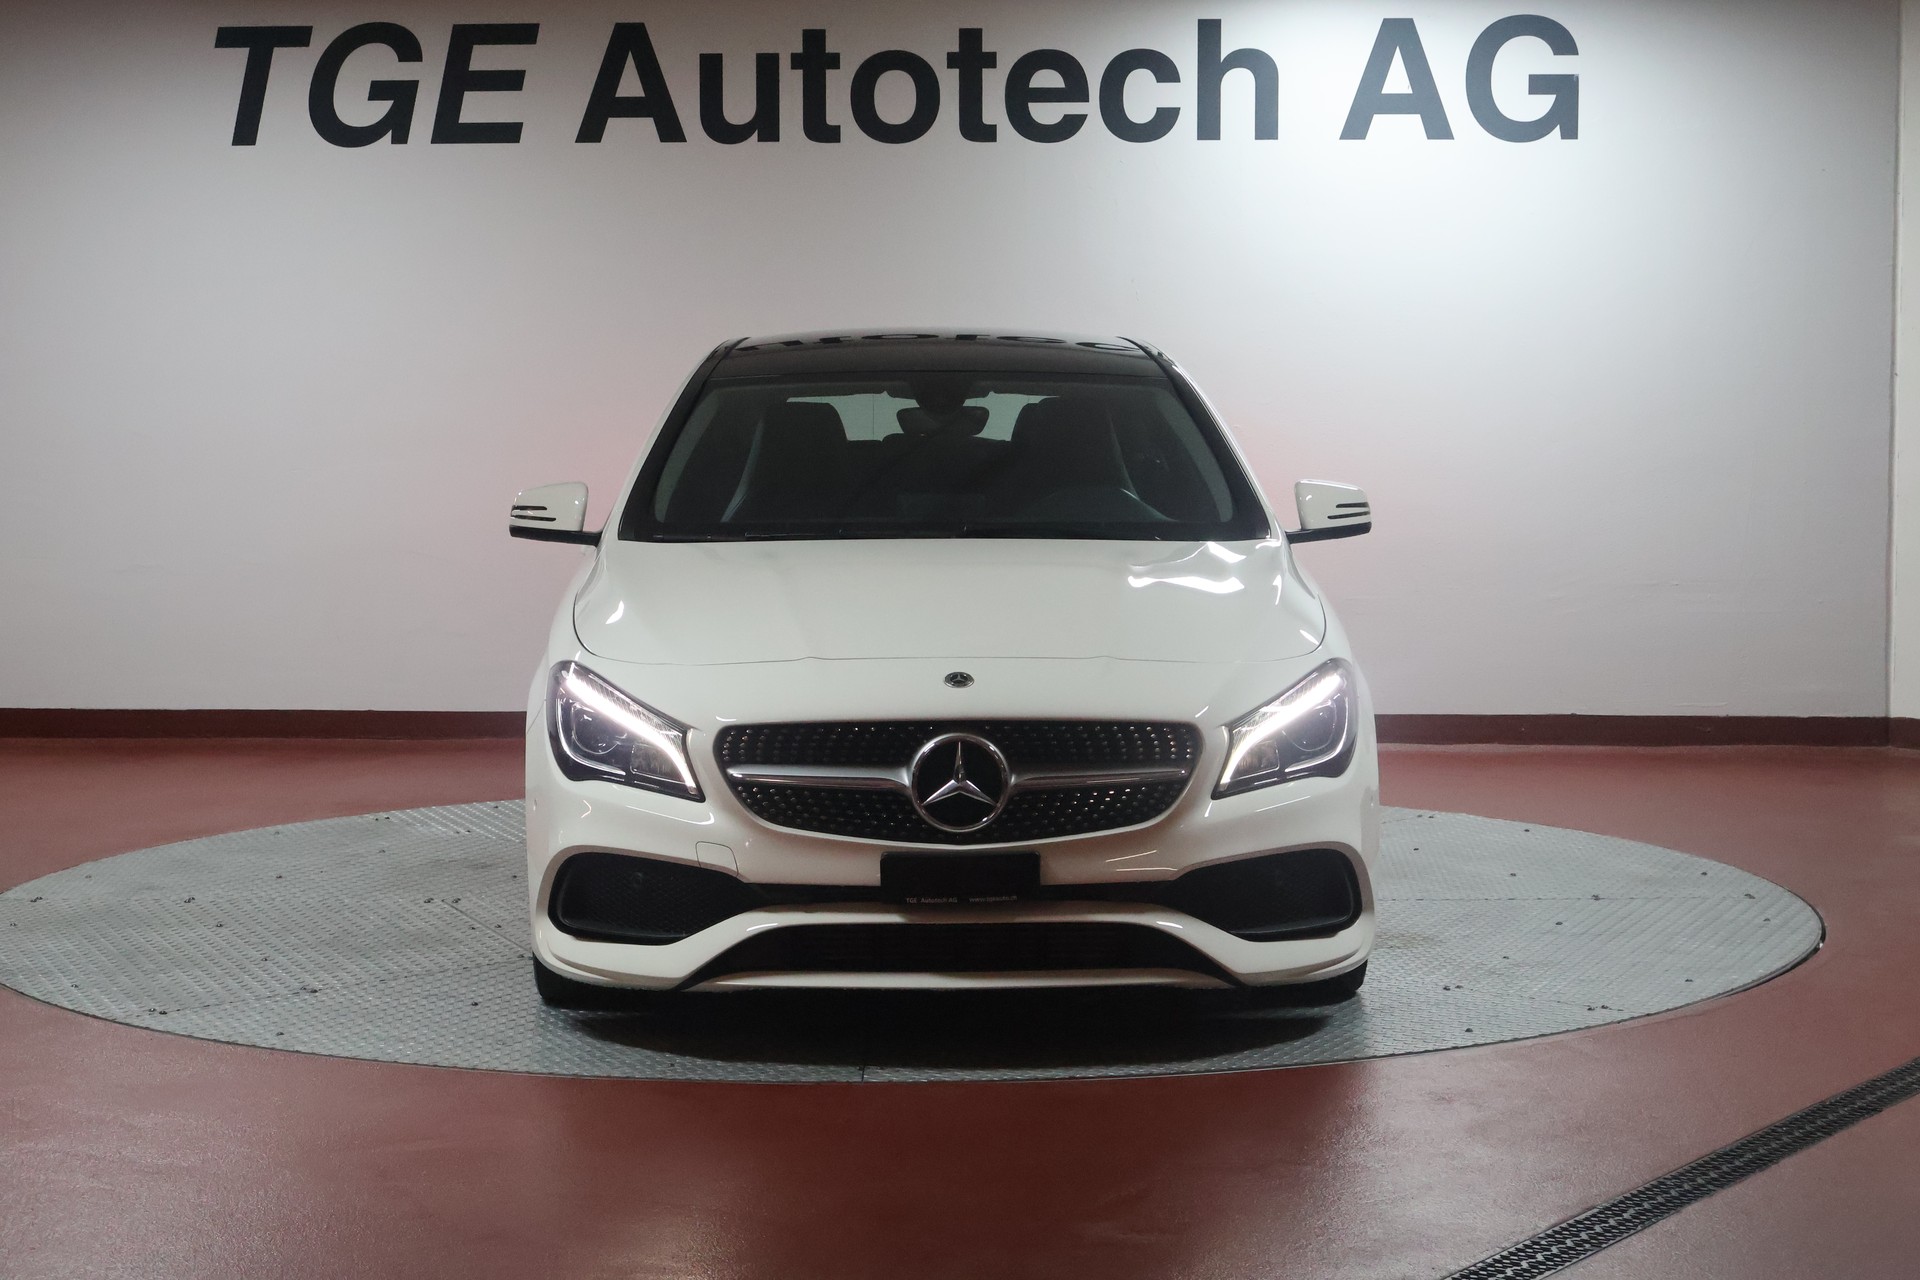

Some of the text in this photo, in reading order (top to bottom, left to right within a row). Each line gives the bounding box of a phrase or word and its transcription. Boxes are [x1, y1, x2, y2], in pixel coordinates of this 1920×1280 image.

[214, 14, 1579, 148] TGE Autotech AG
